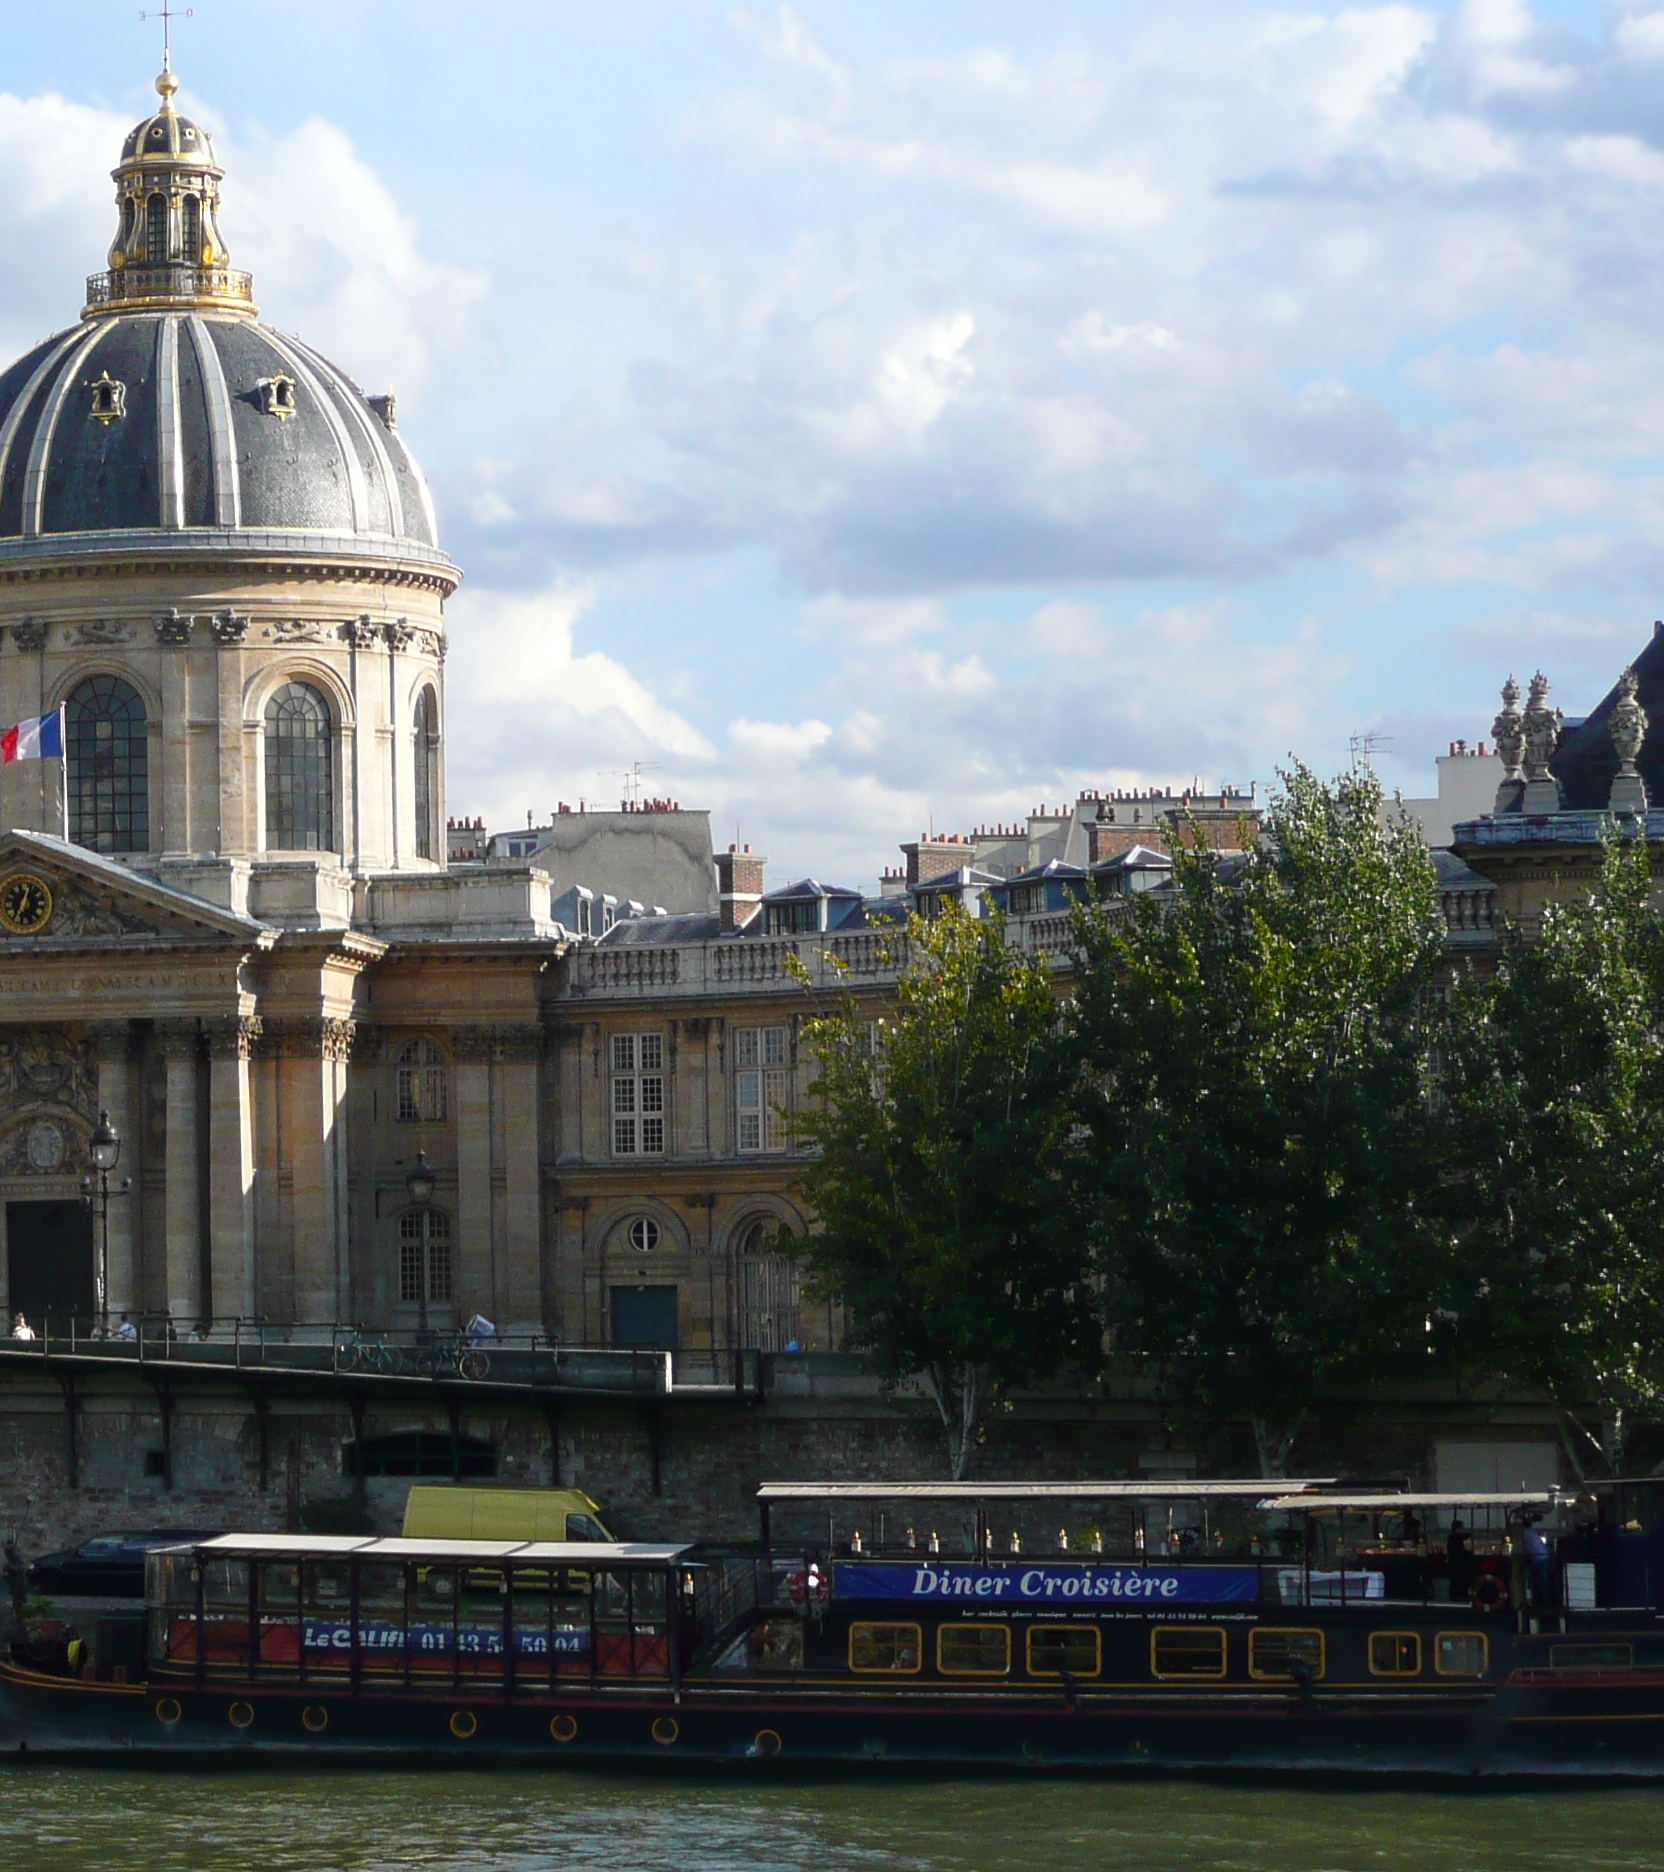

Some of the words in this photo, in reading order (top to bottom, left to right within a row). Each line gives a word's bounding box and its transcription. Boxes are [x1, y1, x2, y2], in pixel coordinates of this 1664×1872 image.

[913, 1569, 1010, 1596] Diner
[1019, 1570, 1180, 1597] Croisière
[421, 1632, 445, 1650] 01
[521, 1636, 548, 1653] 50
[554, 1636, 582, 1653] 04
